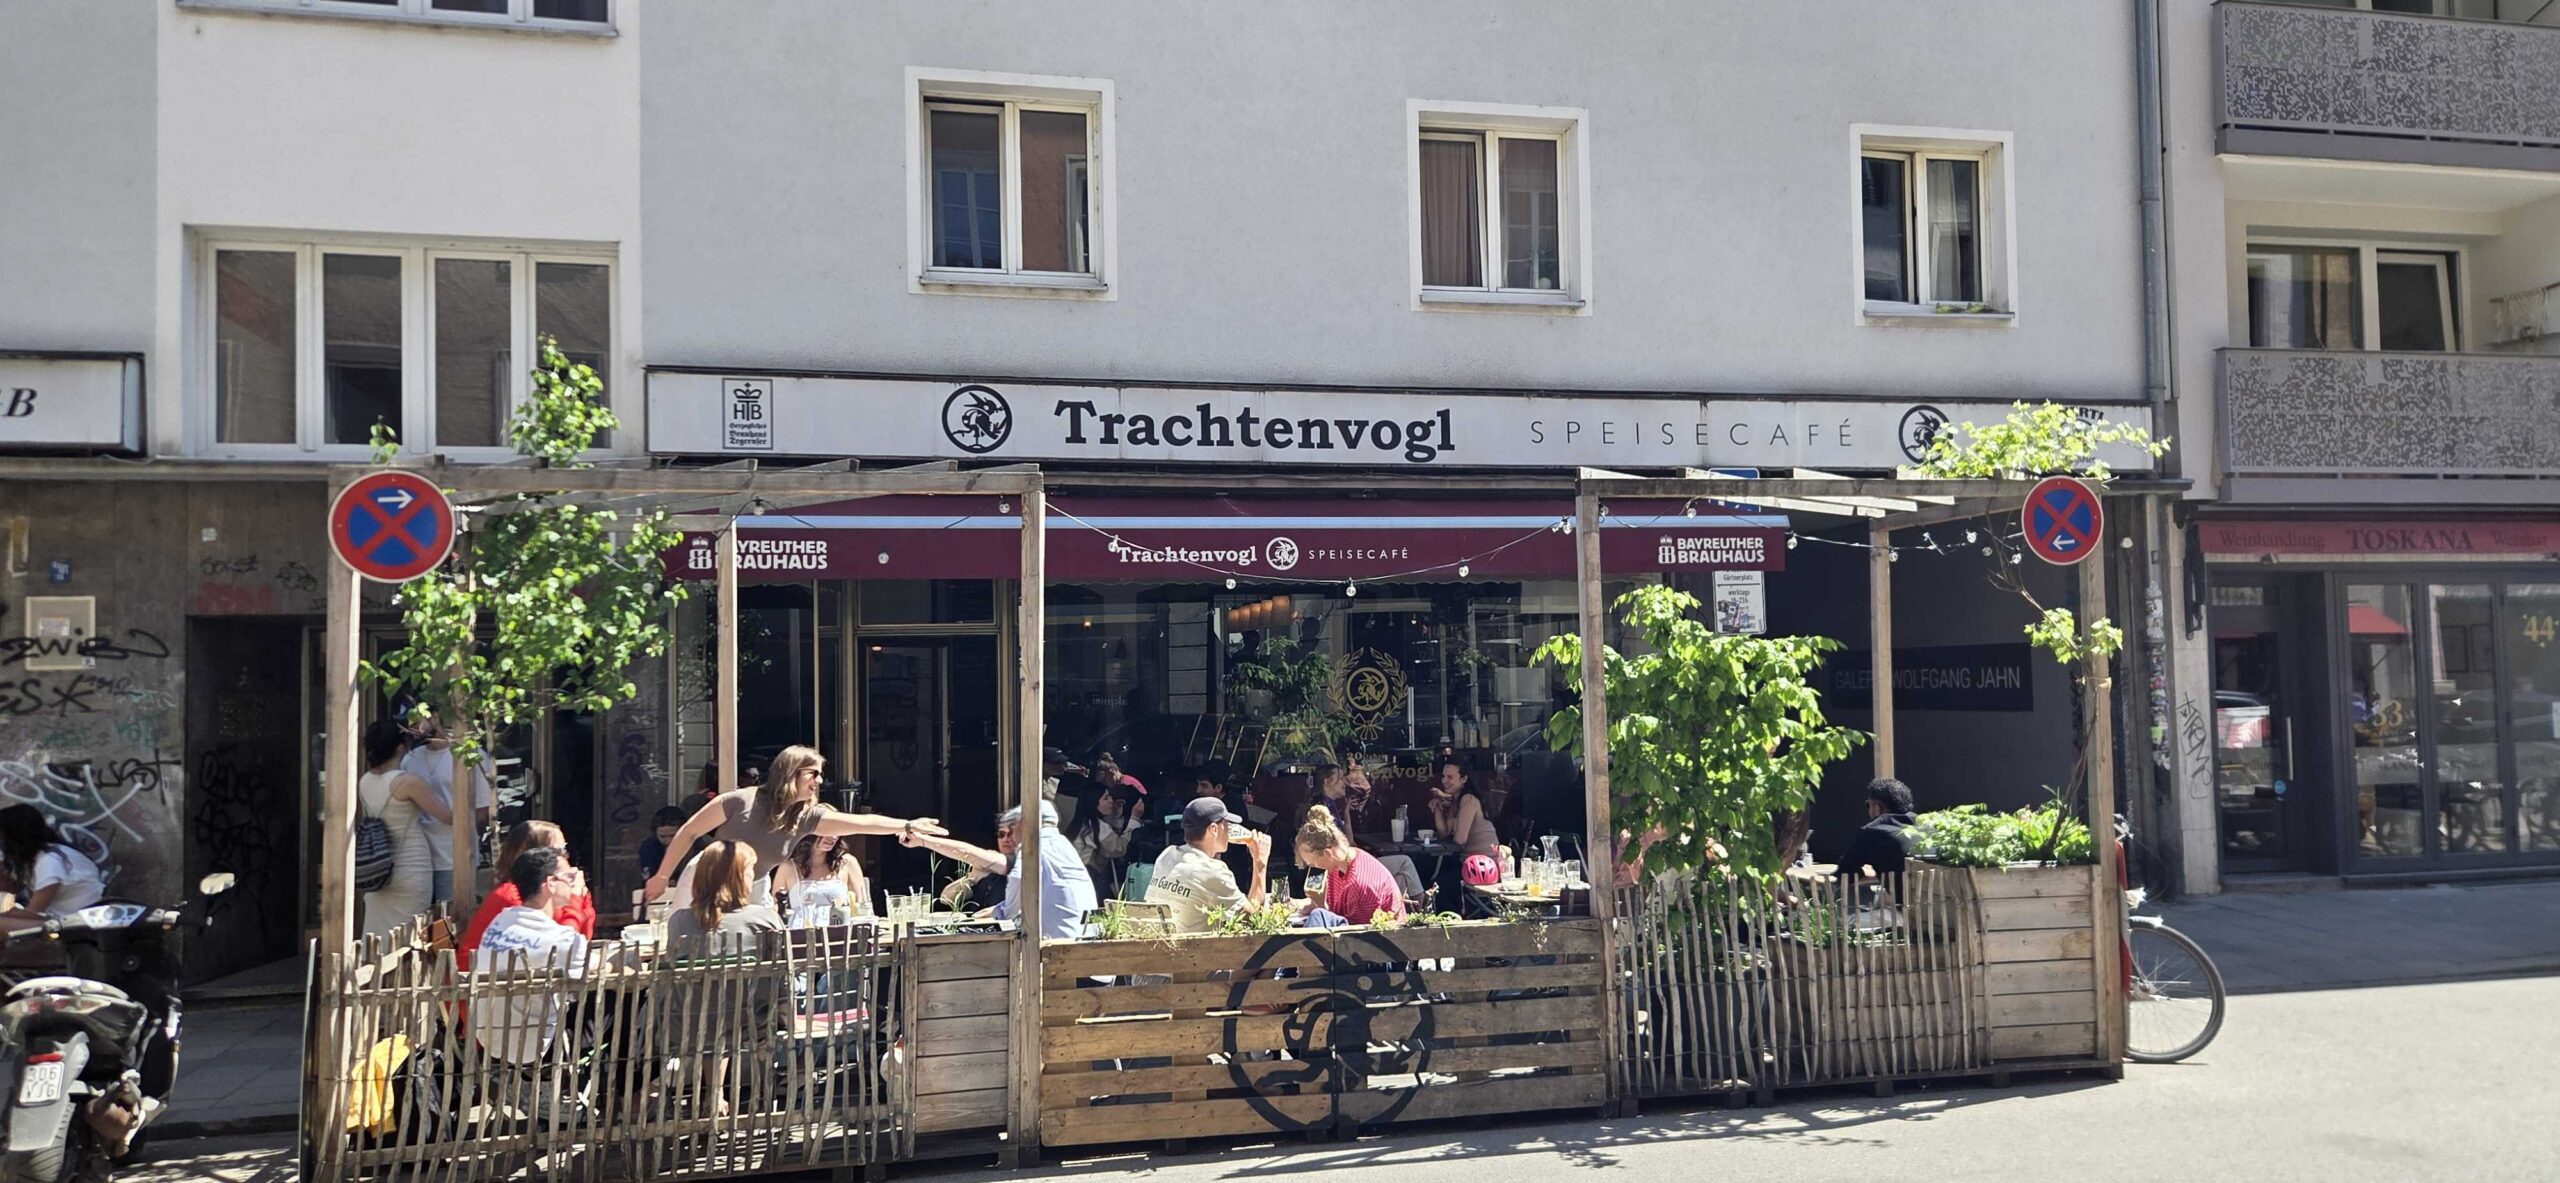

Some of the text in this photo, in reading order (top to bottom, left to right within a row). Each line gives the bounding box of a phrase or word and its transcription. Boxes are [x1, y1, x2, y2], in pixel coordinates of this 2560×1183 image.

[1054, 399, 1853, 463] Trachtenvogl SPEISECAFÉ
[715, 540, 827, 553] YREUTHER
[1677, 537, 1764, 549] BAYREUTHER
[2219, 529, 2326, 551] Weinhandlung
[2346, 528, 2473, 550] TOSKANA
[1117, 545, 1408, 565] Trachtenvogl SPEISECAFÉ
[1678, 549, 1765, 564] BRAUHAUS
[1976, 665, 2020, 689] JAHN
[1158, 876, 1191, 898] Garden
